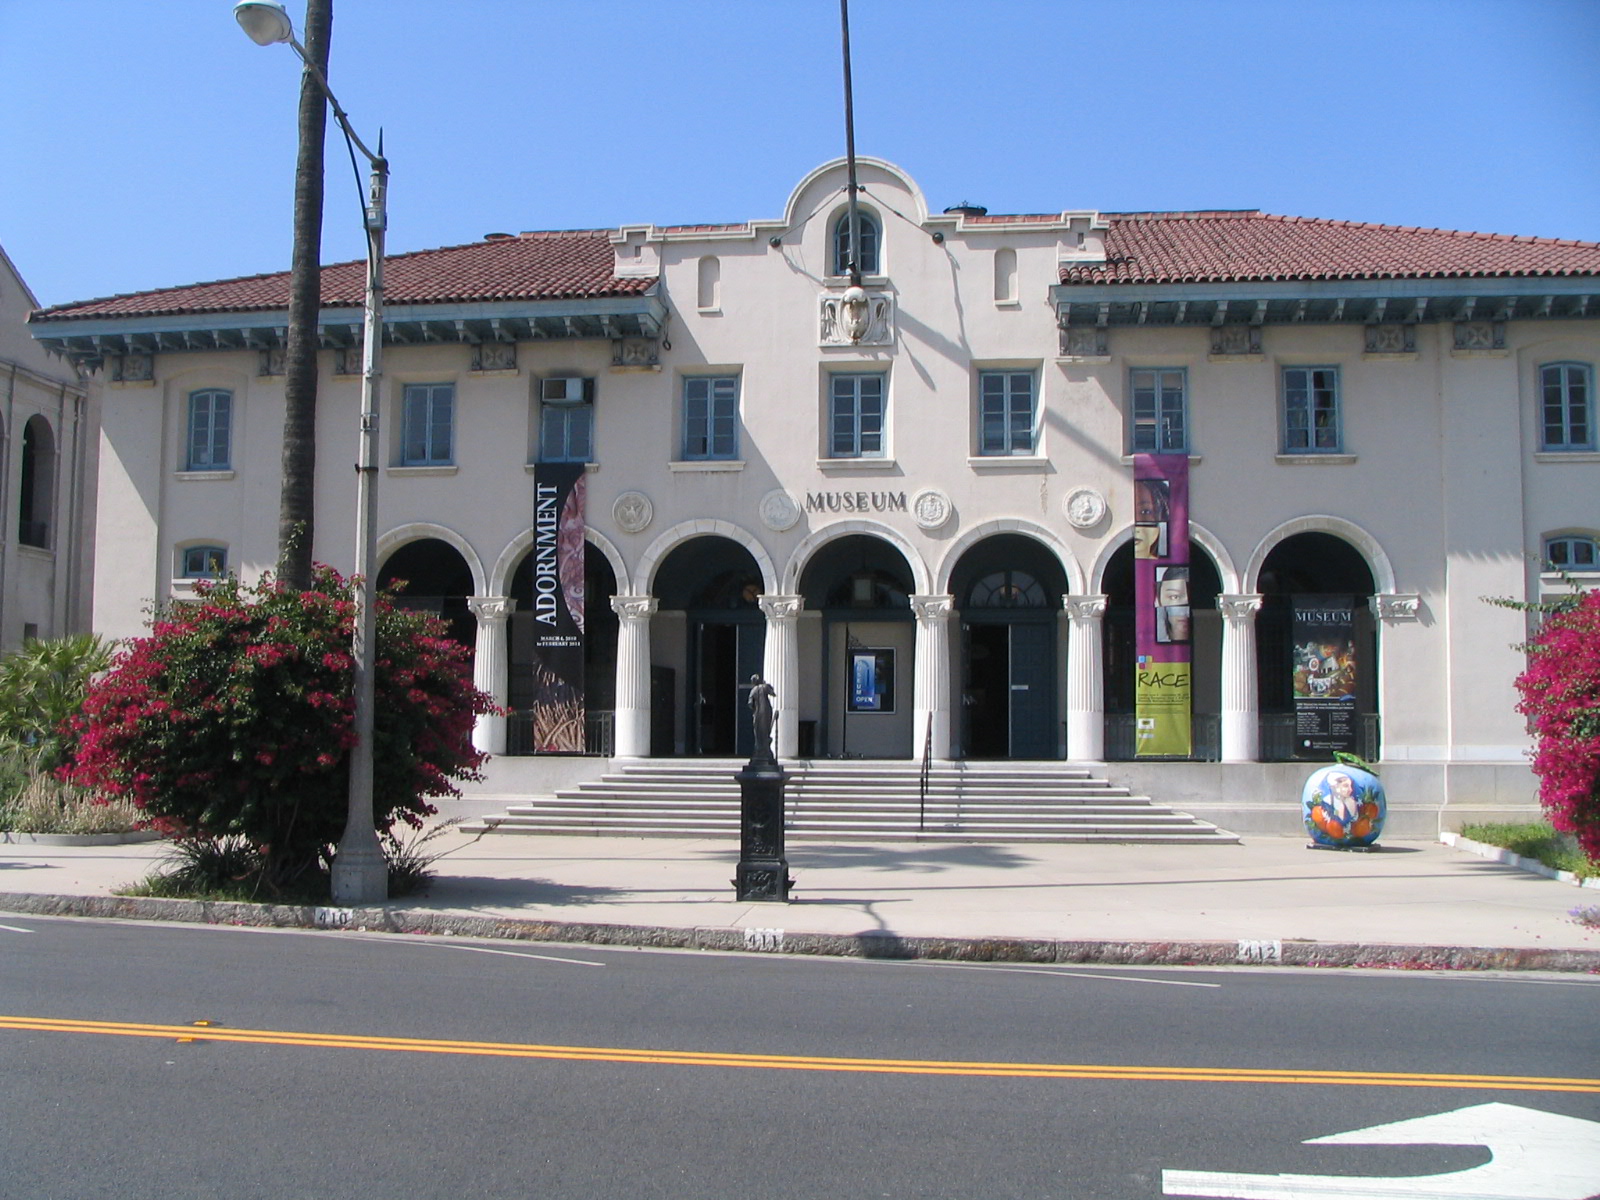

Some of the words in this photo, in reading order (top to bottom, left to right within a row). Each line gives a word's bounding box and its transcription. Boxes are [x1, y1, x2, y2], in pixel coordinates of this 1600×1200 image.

[806, 492, 906, 512] MUSEUM
[535, 483, 557, 627] ADORNMENT
[1296, 612, 1351, 622] MUSEUM
[1138, 672, 1189, 688] RACE
[319, 911, 348, 925] 410
[1243, 945, 1277, 960] 412
